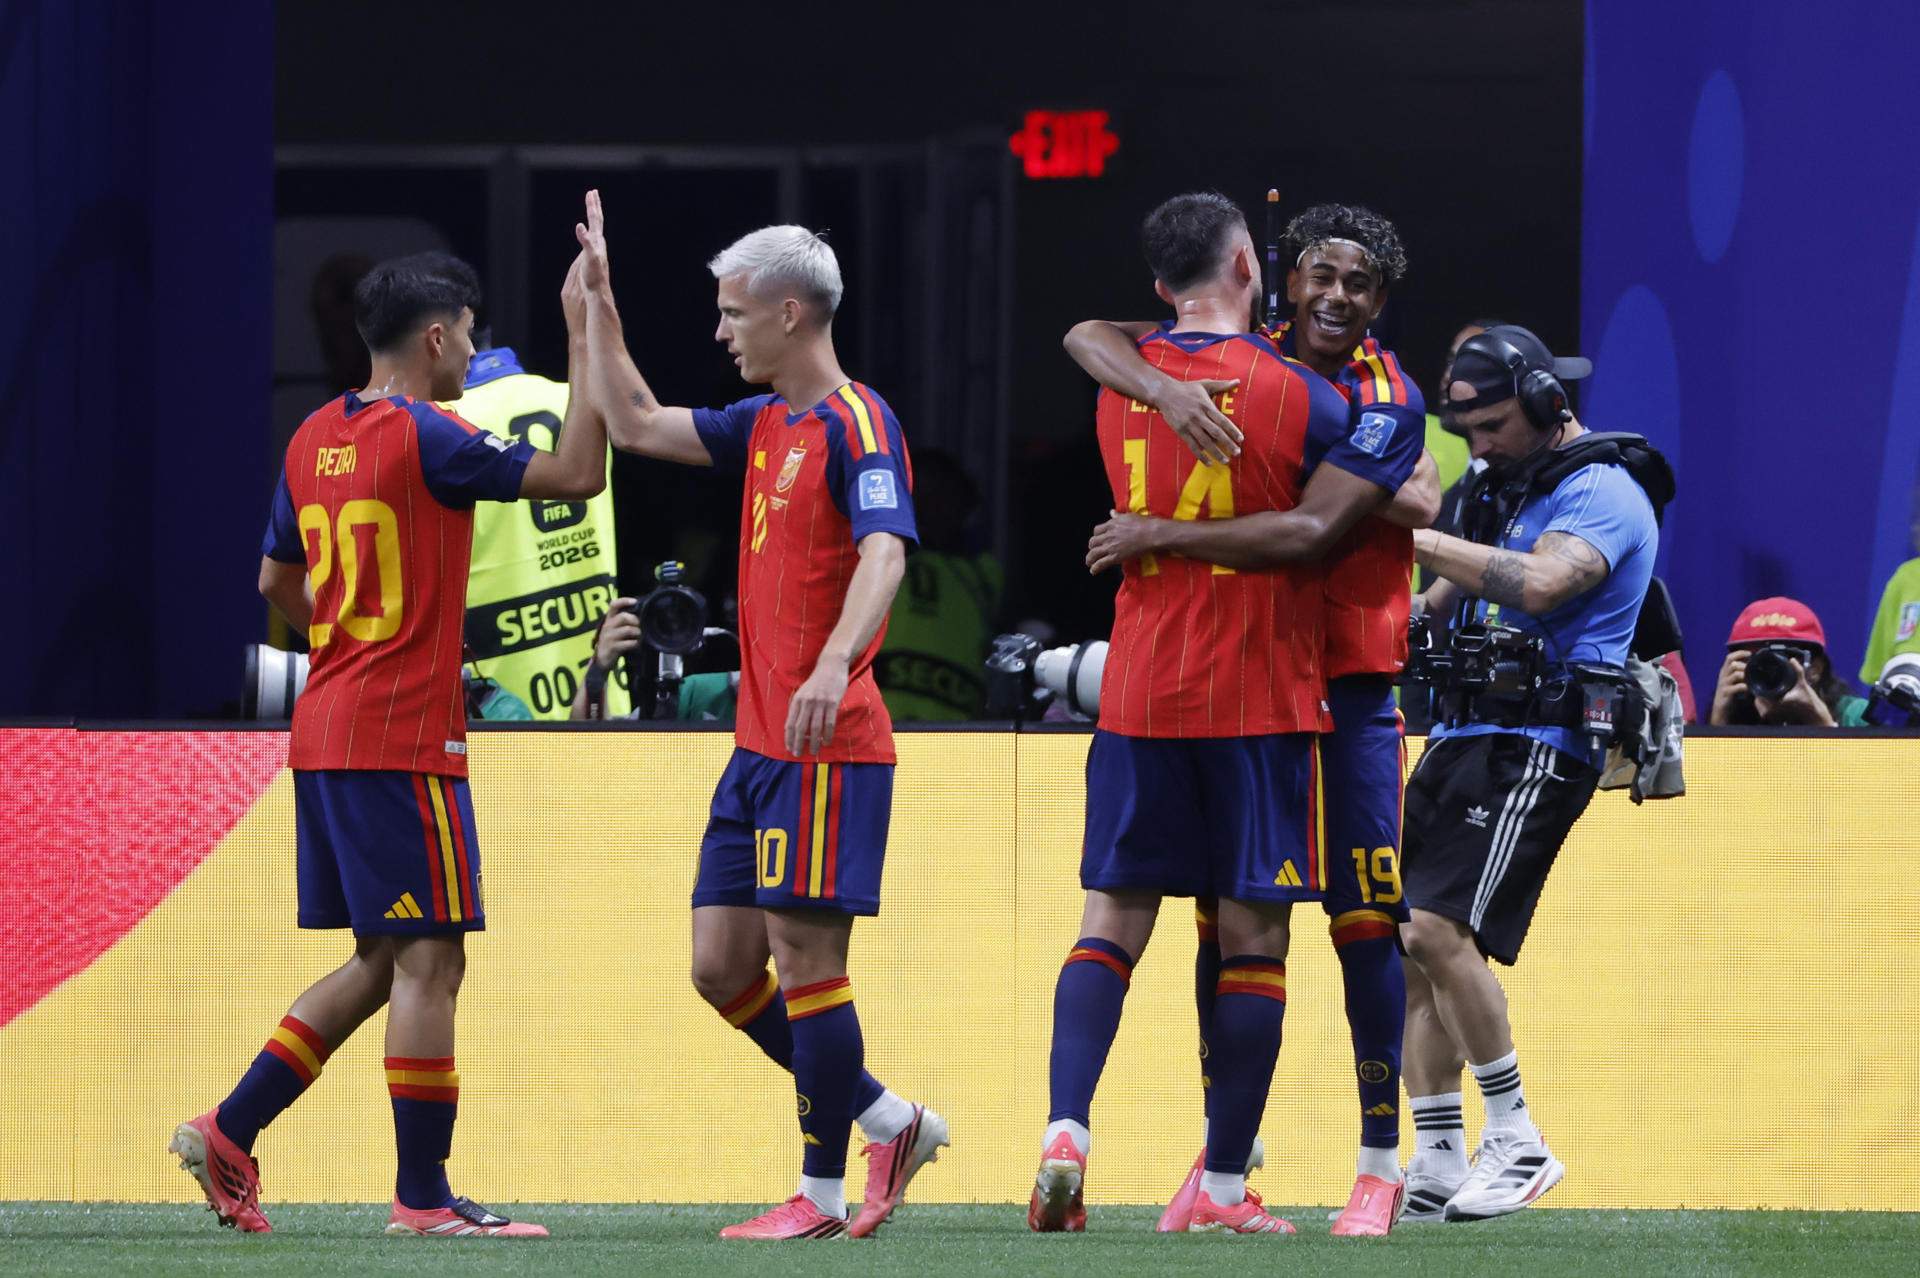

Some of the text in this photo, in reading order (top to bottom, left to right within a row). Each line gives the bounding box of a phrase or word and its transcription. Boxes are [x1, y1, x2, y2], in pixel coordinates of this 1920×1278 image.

[315, 444, 357, 477] PEDRI
[543, 503, 572, 524] FIFA
[1123, 438, 1237, 576] 14
[537, 527, 595, 551] WORLD CUP
[539, 541, 600, 571] 2026
[299, 499, 404, 649] 20
[755, 828, 788, 888] 10
[1352, 846, 1402, 904] 19
